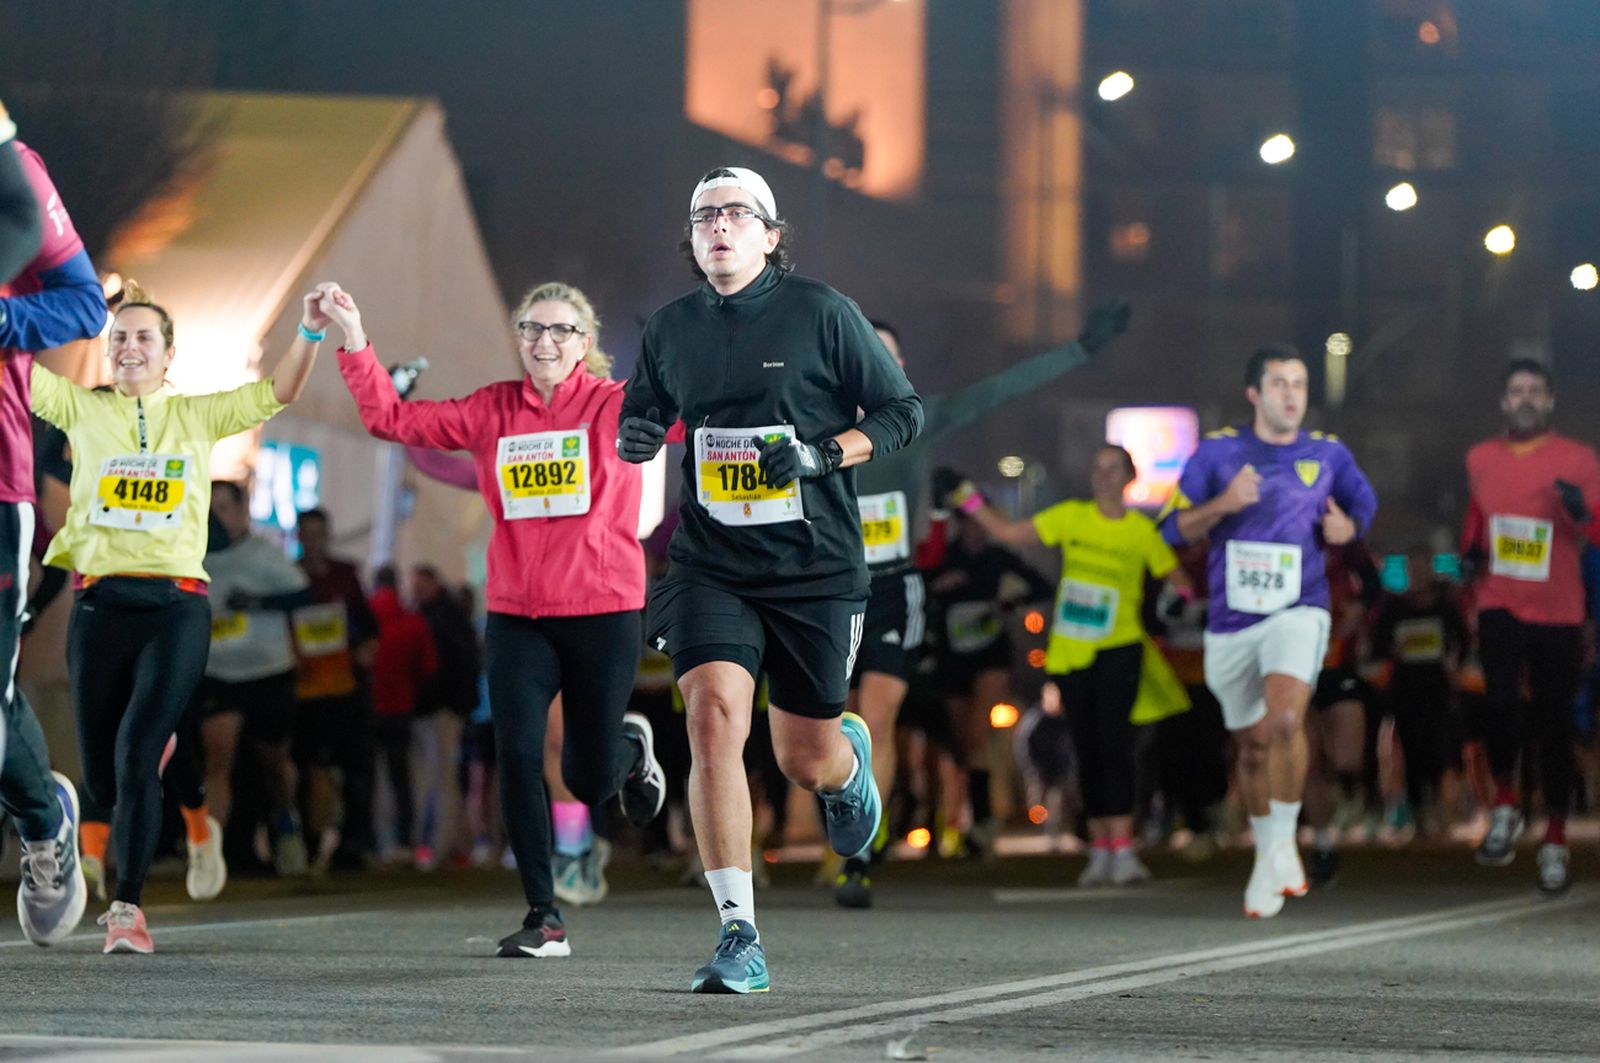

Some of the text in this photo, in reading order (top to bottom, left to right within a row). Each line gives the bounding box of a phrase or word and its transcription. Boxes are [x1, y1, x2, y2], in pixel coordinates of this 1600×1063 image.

[544, 440, 553, 450] DE
[715, 439, 742, 449] NOCHE
[507, 454, 524, 464] SAN
[707, 447, 756, 462] SAN ANTÓN
[508, 460, 576, 489] 12892
[114, 478, 169, 504] 4148
[1238, 569, 1285, 590] 5628
